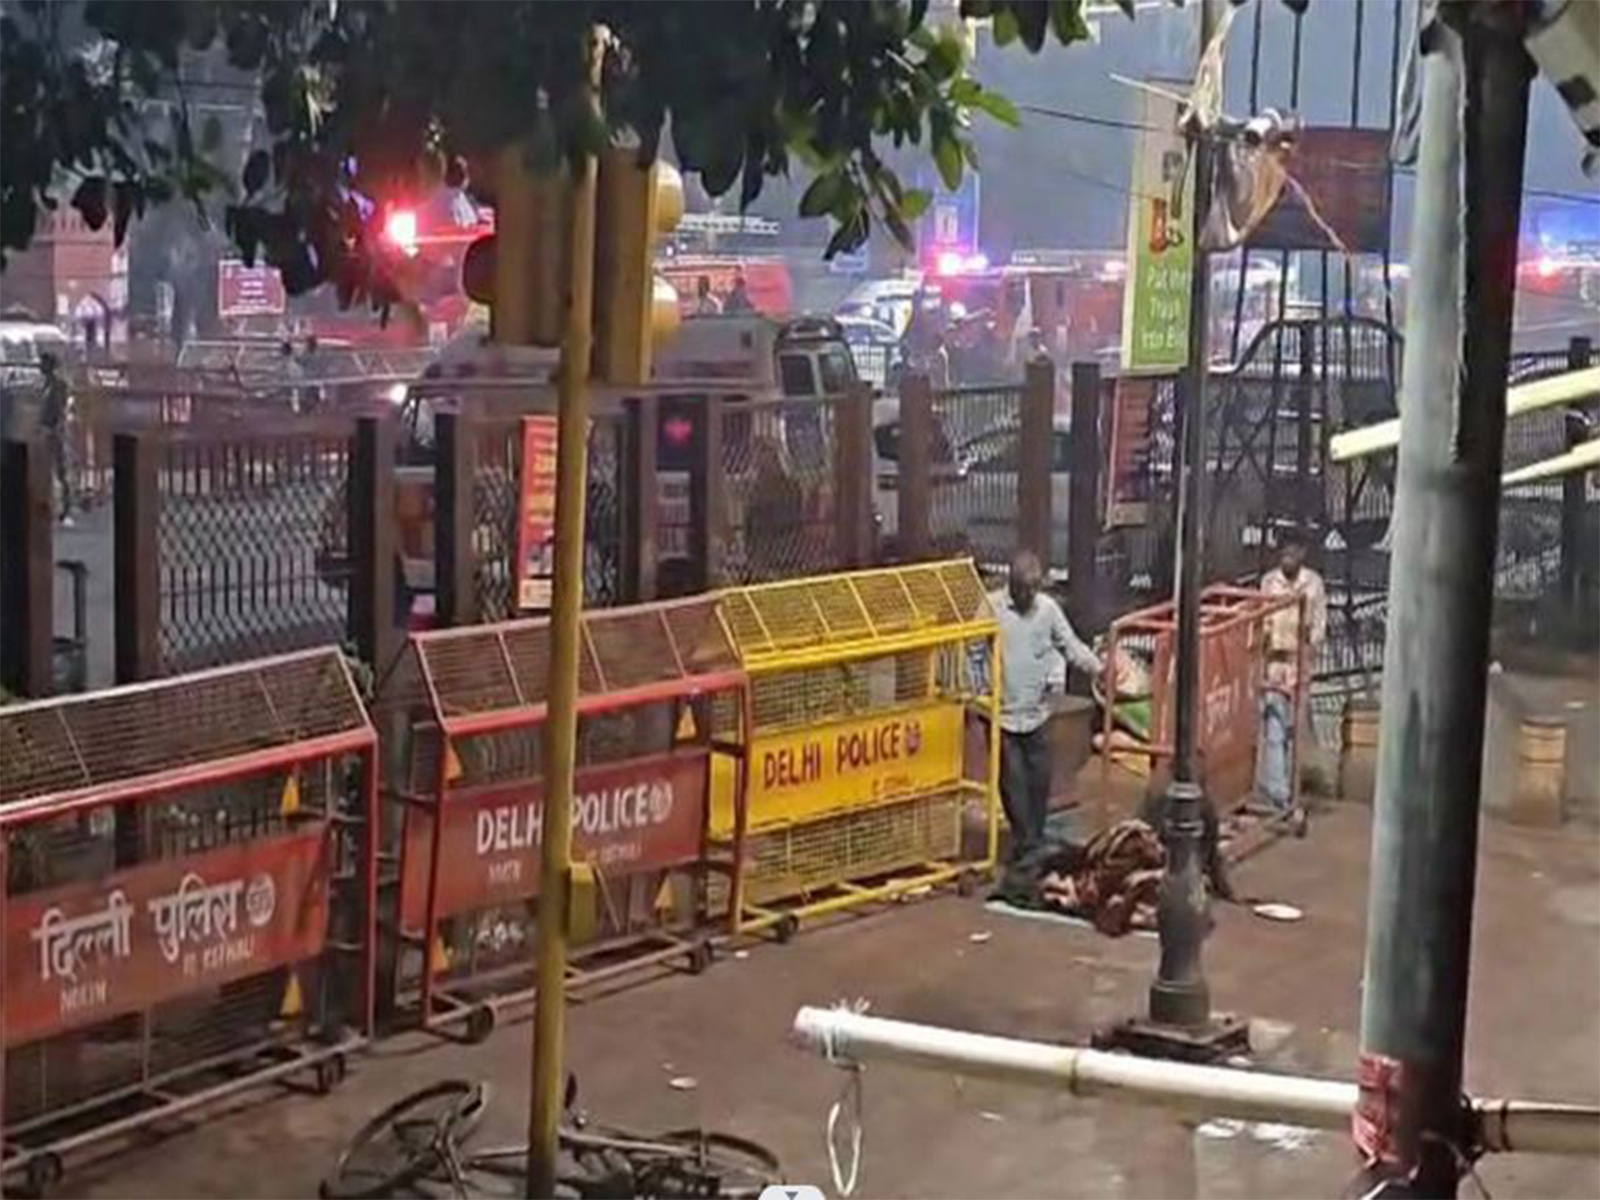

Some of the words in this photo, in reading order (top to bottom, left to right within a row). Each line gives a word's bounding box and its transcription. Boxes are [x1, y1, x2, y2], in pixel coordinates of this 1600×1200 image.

[764, 743, 821, 790] DELHI
[837, 720, 901, 773] POLICE
[477, 801, 543, 855] DELH
[32, 889, 134, 982] दिल्ली
[149, 873, 244, 963] पुलिस
